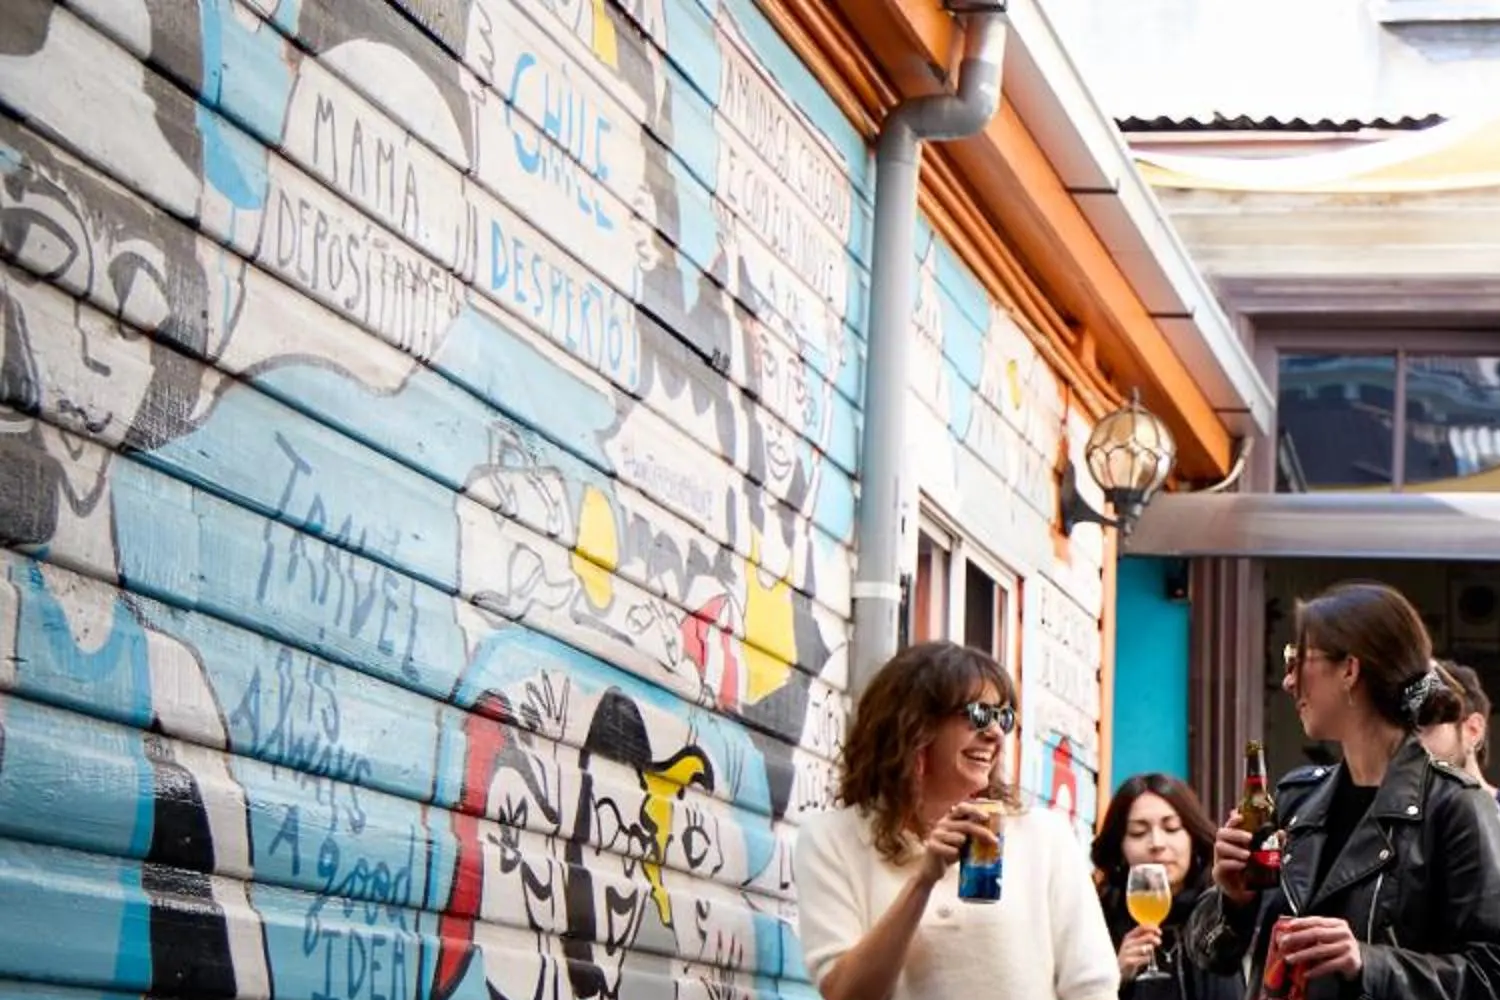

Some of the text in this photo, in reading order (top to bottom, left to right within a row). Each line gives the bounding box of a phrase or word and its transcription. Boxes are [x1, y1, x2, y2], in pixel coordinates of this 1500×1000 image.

[506, 51, 614, 231] CHILE
[256, 431, 421, 684] TRAVEL
[270, 803, 299, 877] A
